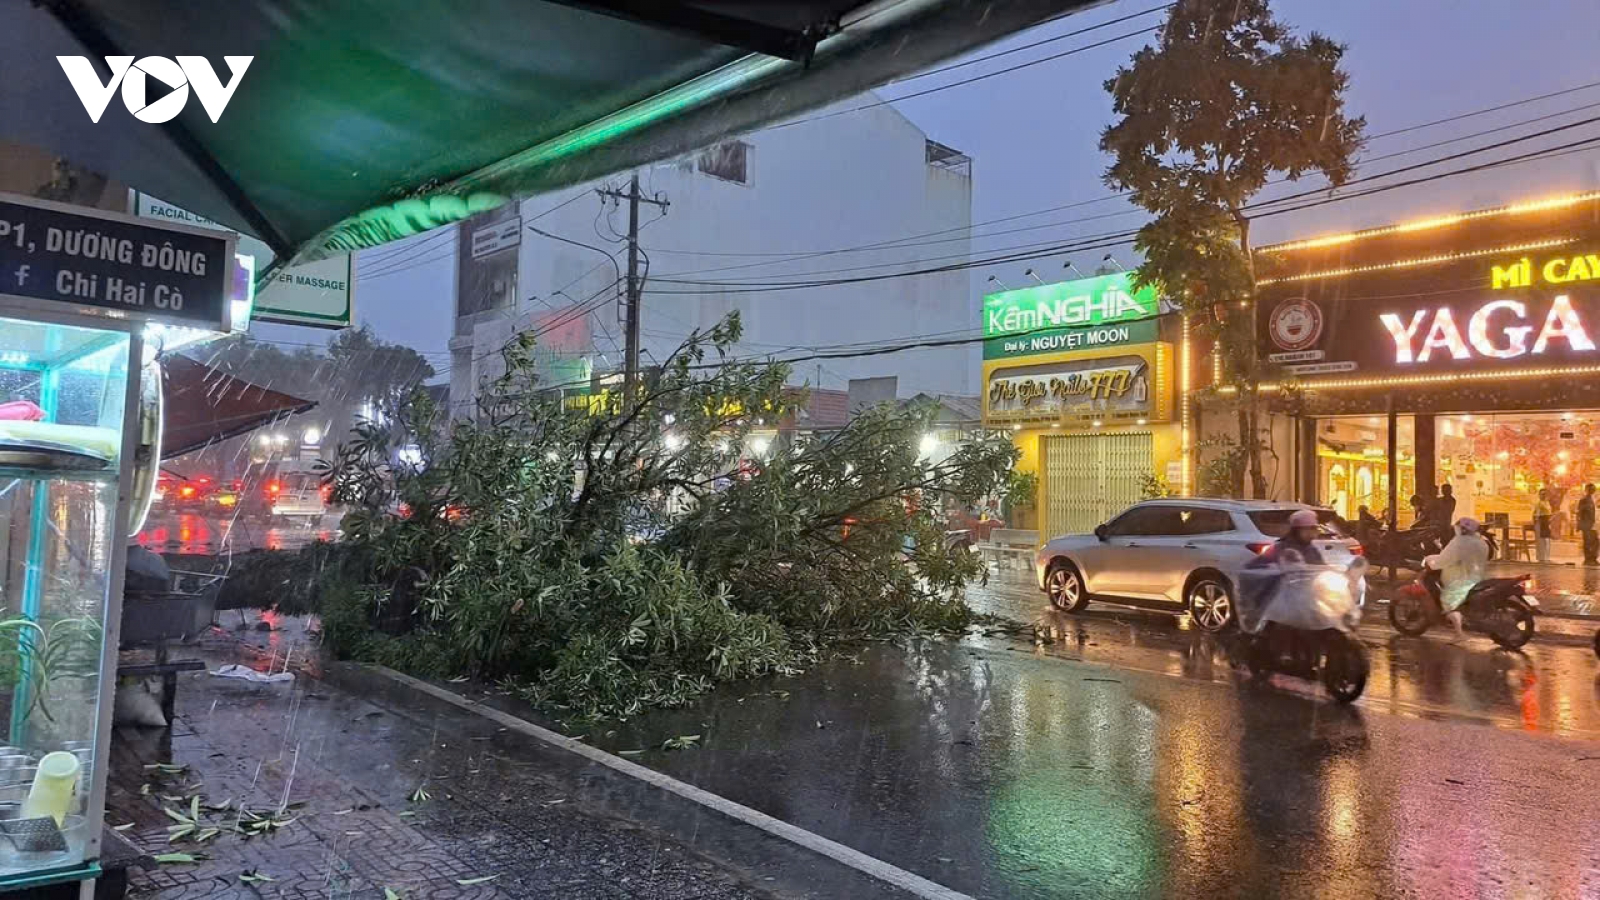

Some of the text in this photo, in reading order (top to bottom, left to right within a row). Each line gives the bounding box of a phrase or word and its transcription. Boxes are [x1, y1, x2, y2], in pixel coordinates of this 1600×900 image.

[150, 205, 191, 221] FACIAL
[45, 227, 135, 265] DƯƠNG
[140, 241, 207, 276] ĐÔNG
[295, 275, 346, 291] MASSAGE
[1492, 257, 1531, 289] MÌ
[105, 277, 146, 306] Hai
[153, 286, 184, 311] Cò
[1031, 330, 1084, 351] NGUYỆT
[1086, 327, 1129, 345] MOON
[1379, 294, 1596, 363] YAGA
[1049, 373, 1091, 401] Nails
[1090, 369, 1131, 400] 777
